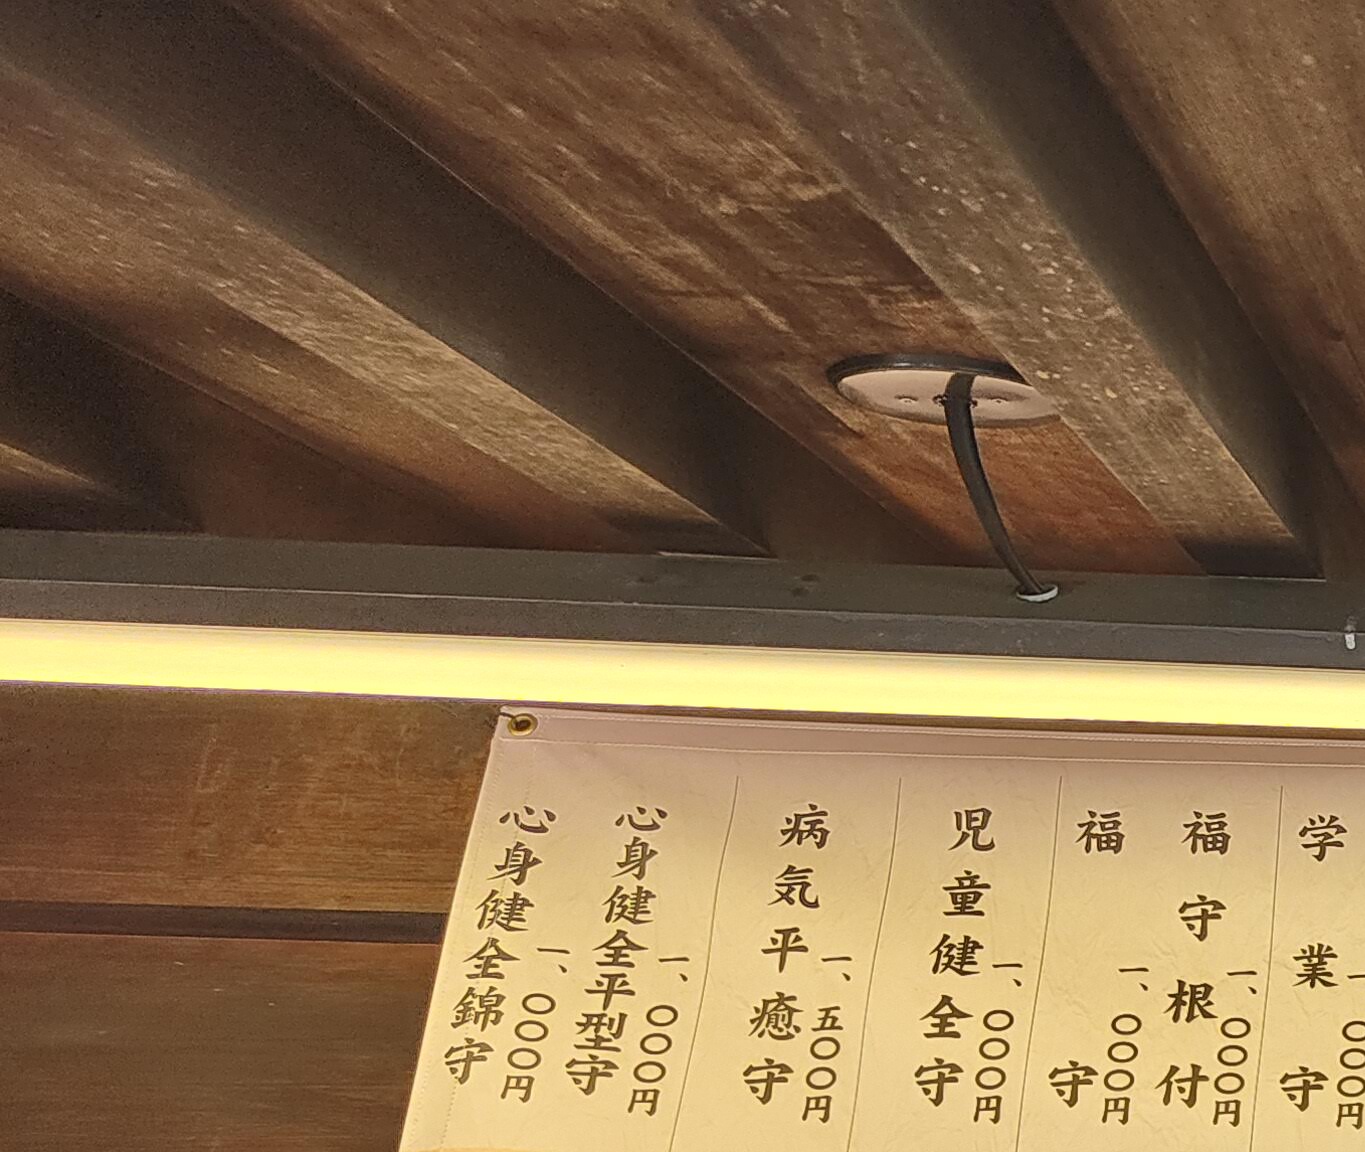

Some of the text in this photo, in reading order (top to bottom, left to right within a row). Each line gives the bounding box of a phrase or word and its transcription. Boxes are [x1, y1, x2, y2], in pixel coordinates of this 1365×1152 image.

[443, 805, 557, 1085] 心身健全錦守
[564, 806, 668, 1096] 心身健全平型守
[742, 803, 831, 1106] 病気平癒守
[914, 807, 996, 1108] 児童健全守
[1048, 809, 1126, 1109] 福守
[1154, 810, 1232, 1109] 福守根付
[1279, 814, 1348, 1113] 学業守
